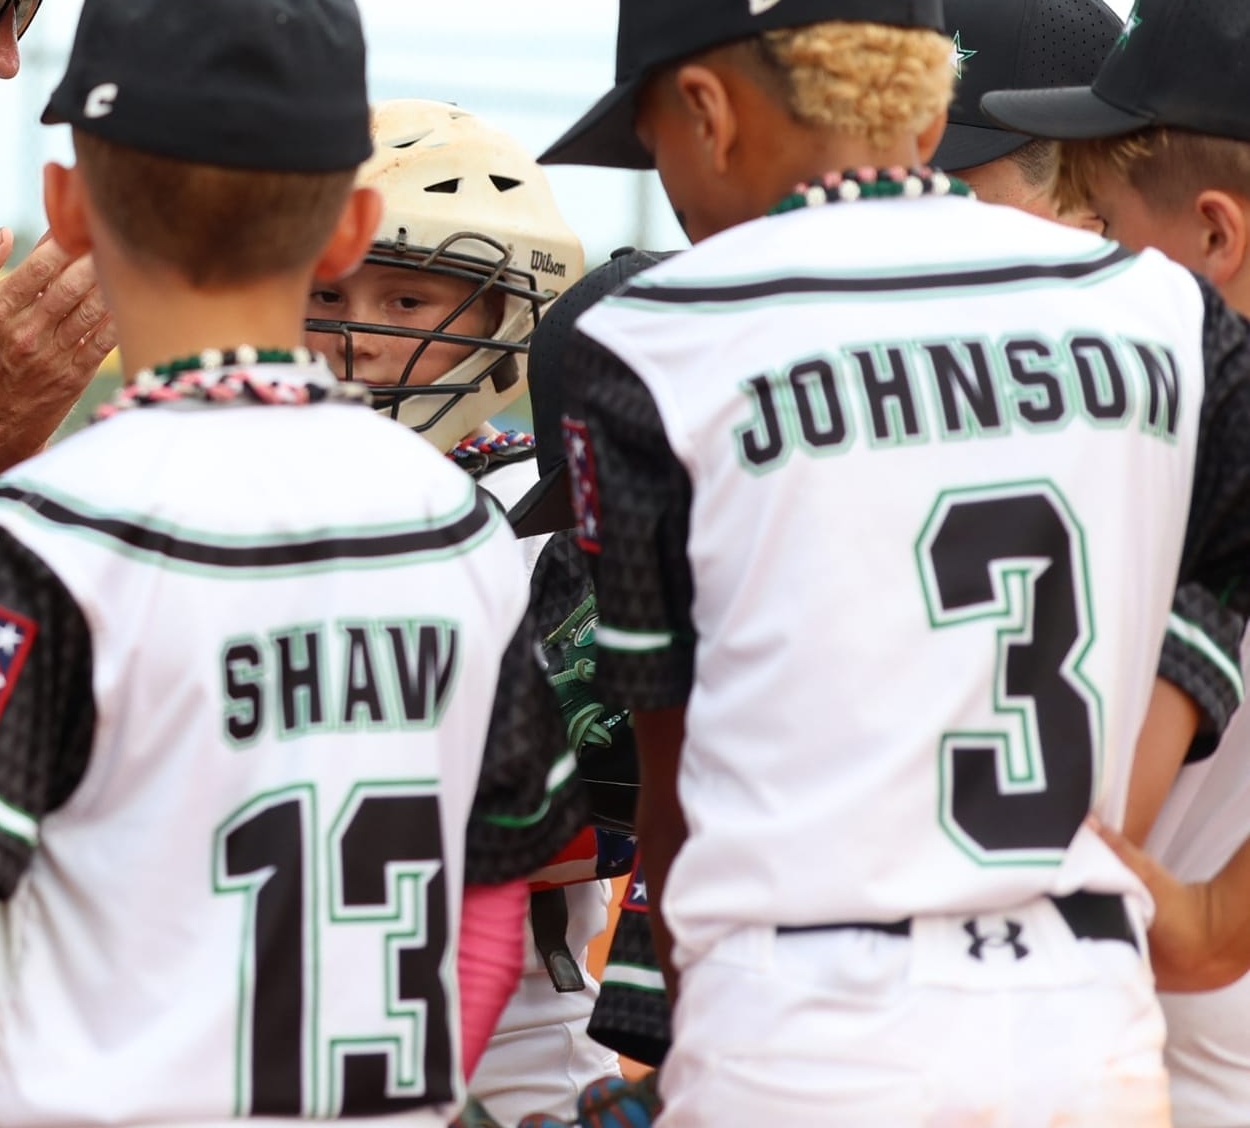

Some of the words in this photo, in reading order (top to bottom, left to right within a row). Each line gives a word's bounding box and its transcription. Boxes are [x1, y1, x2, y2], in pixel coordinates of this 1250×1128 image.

[531, 249, 566, 278] Wilson
[733, 329, 1182, 477] JOHNSON
[219, 617, 463, 751] SHAW
[915, 477, 1104, 867] 3
[212, 780, 466, 1120] 13
